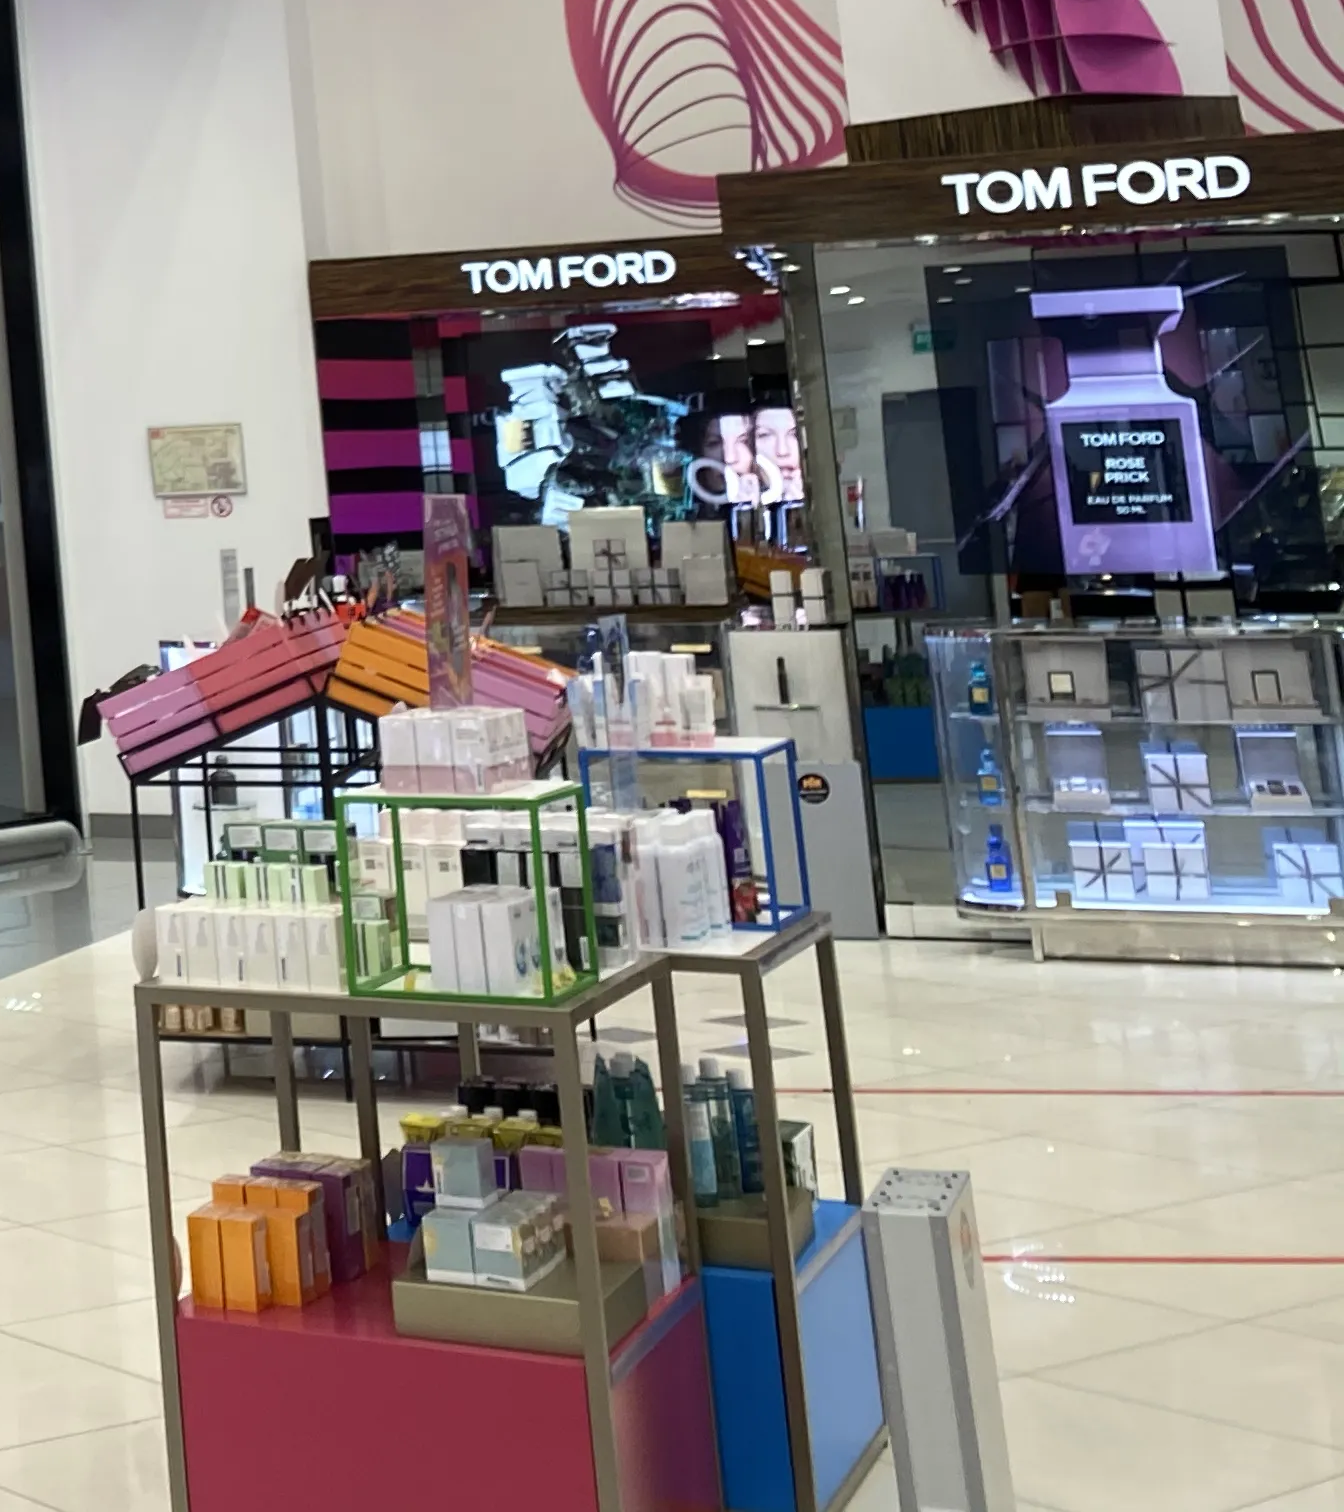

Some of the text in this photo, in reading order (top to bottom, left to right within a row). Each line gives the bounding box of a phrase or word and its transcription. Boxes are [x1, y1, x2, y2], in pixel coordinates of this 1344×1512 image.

[941, 155, 1251, 216] TOM FORD
[461, 250, 677, 295] TOM FORD
[1080, 430, 1165, 447] TOM FORD
[1104, 456, 1146, 470] ROSE
[1104, 471, 1150, 484] PRICK
[1086, 495, 1111, 506] EAU
[1128, 492, 1173, 504] PARFUM
